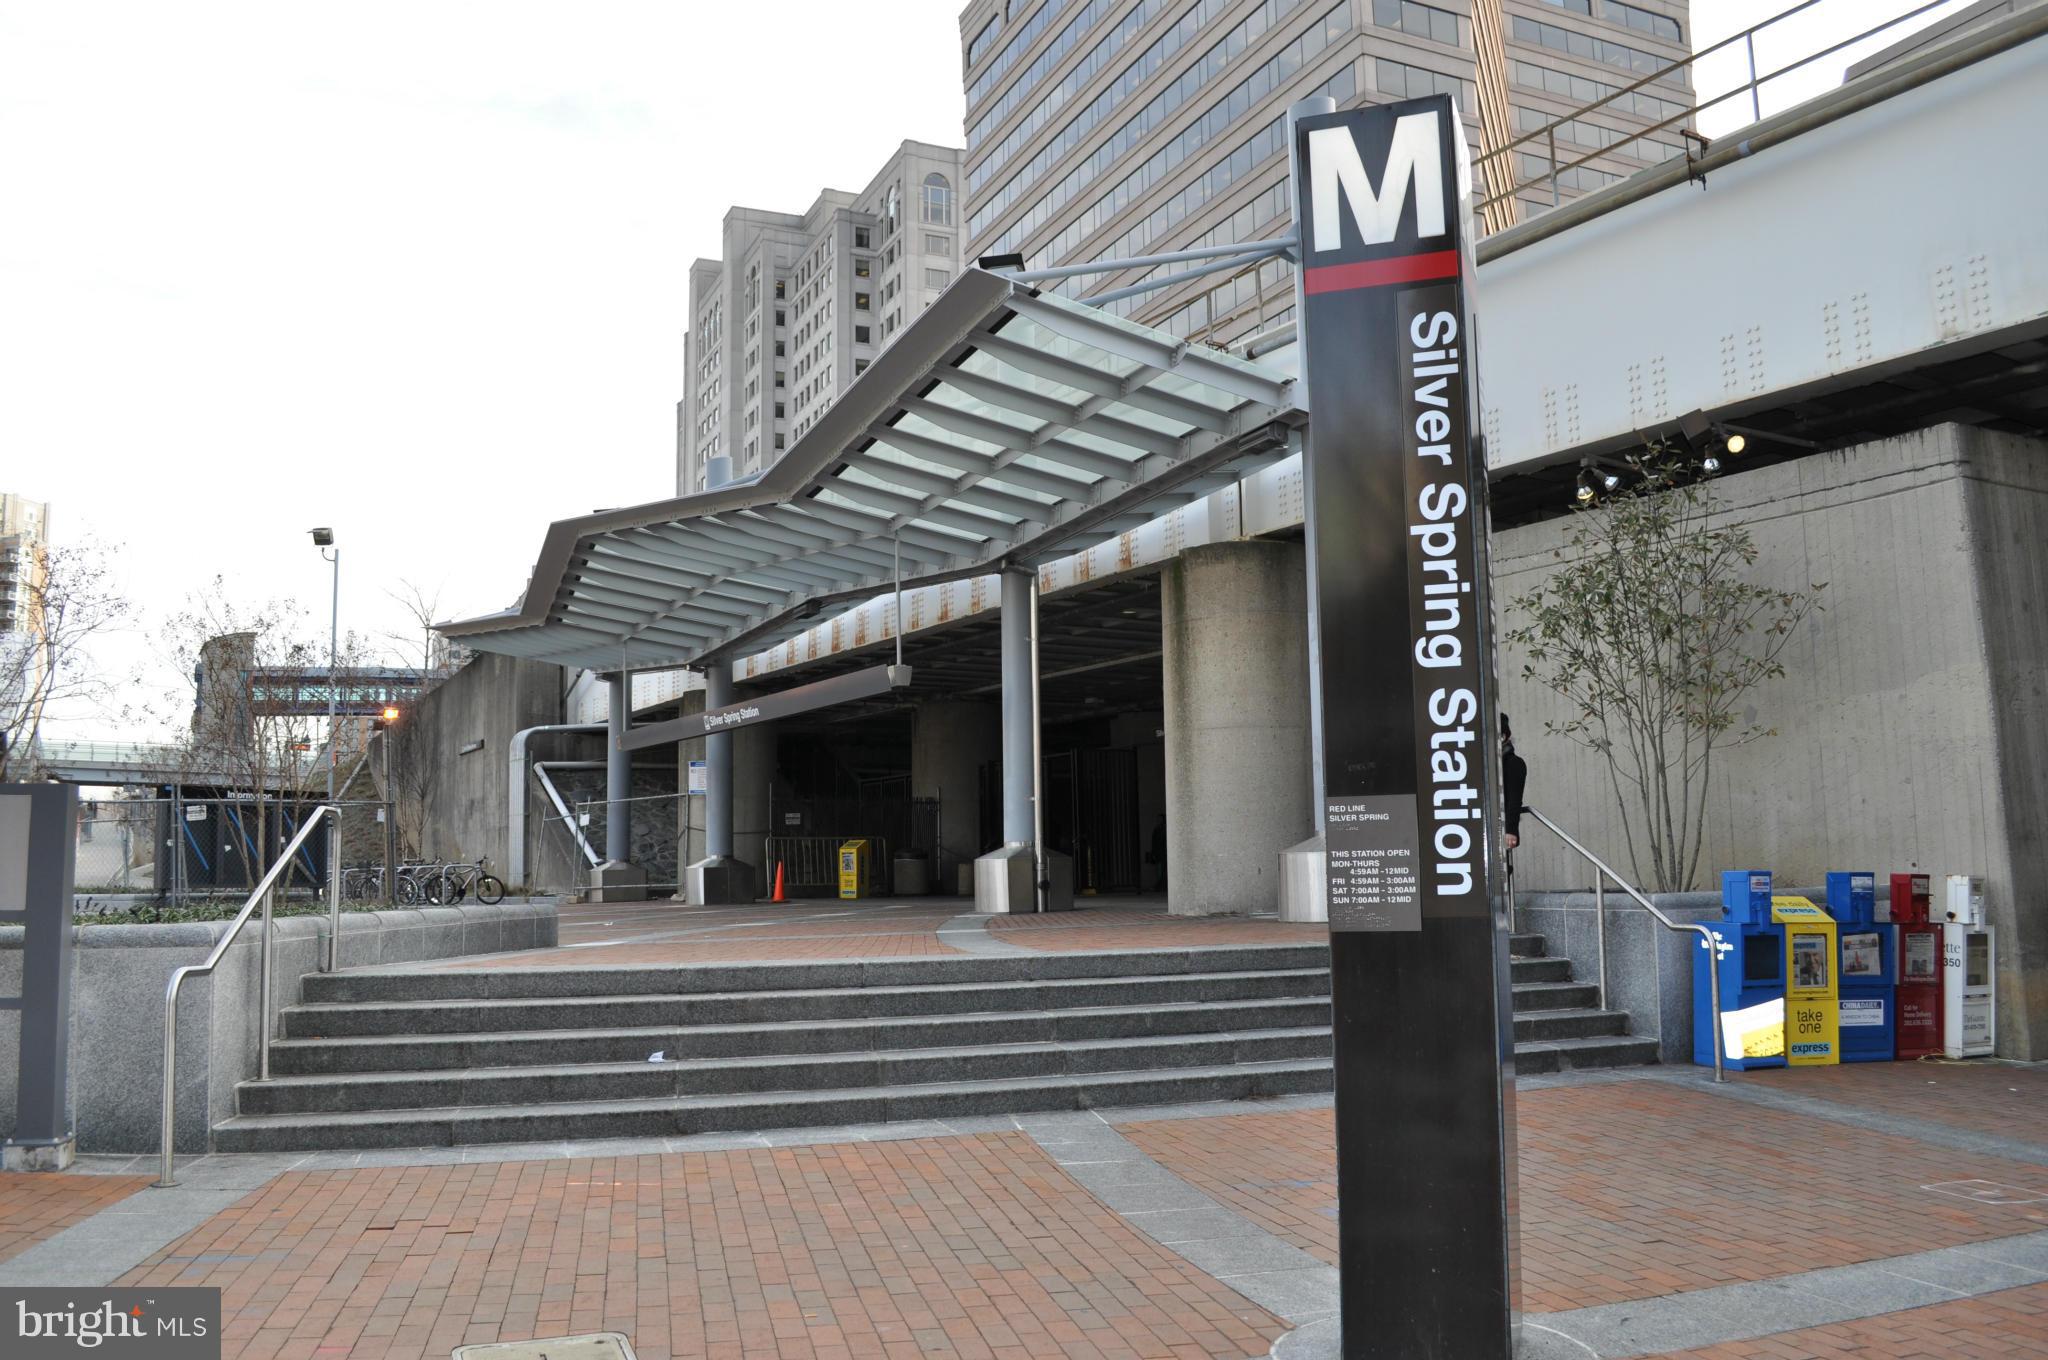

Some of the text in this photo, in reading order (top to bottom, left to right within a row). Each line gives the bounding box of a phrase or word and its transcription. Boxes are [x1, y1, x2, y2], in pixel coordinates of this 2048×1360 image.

[1308, 110, 1446, 253] M
[1410, 311, 1482, 896] Silver Spring Station
[710, 715, 723, 727] Silver
[723, 712, 741, 726] Spring
[740, 706, 760, 719] Station
[1329, 804, 1366, 813] RED LINE
[1329, 813, 1390, 822] SILVER SPRING
[1331, 849, 1410, 858] THIS STATION OPEN
[1331, 860, 1380, 868] MON-THURS
[1350, 867, 1379, 875] 4:59AM
[1350, 877, 1379, 885] 4:59AM
[1386, 876, 1415, 884] 3:00AM
[1332, 887, 1348, 895] SAT
[1387, 886, 1416, 894] 3:00AM
[1333, 896, 1350, 904] SUN
[1797, 1008, 1823, 1022] take
[1798, 1023, 1822, 1034] one
[1791, 1043, 1829, 1054] express
